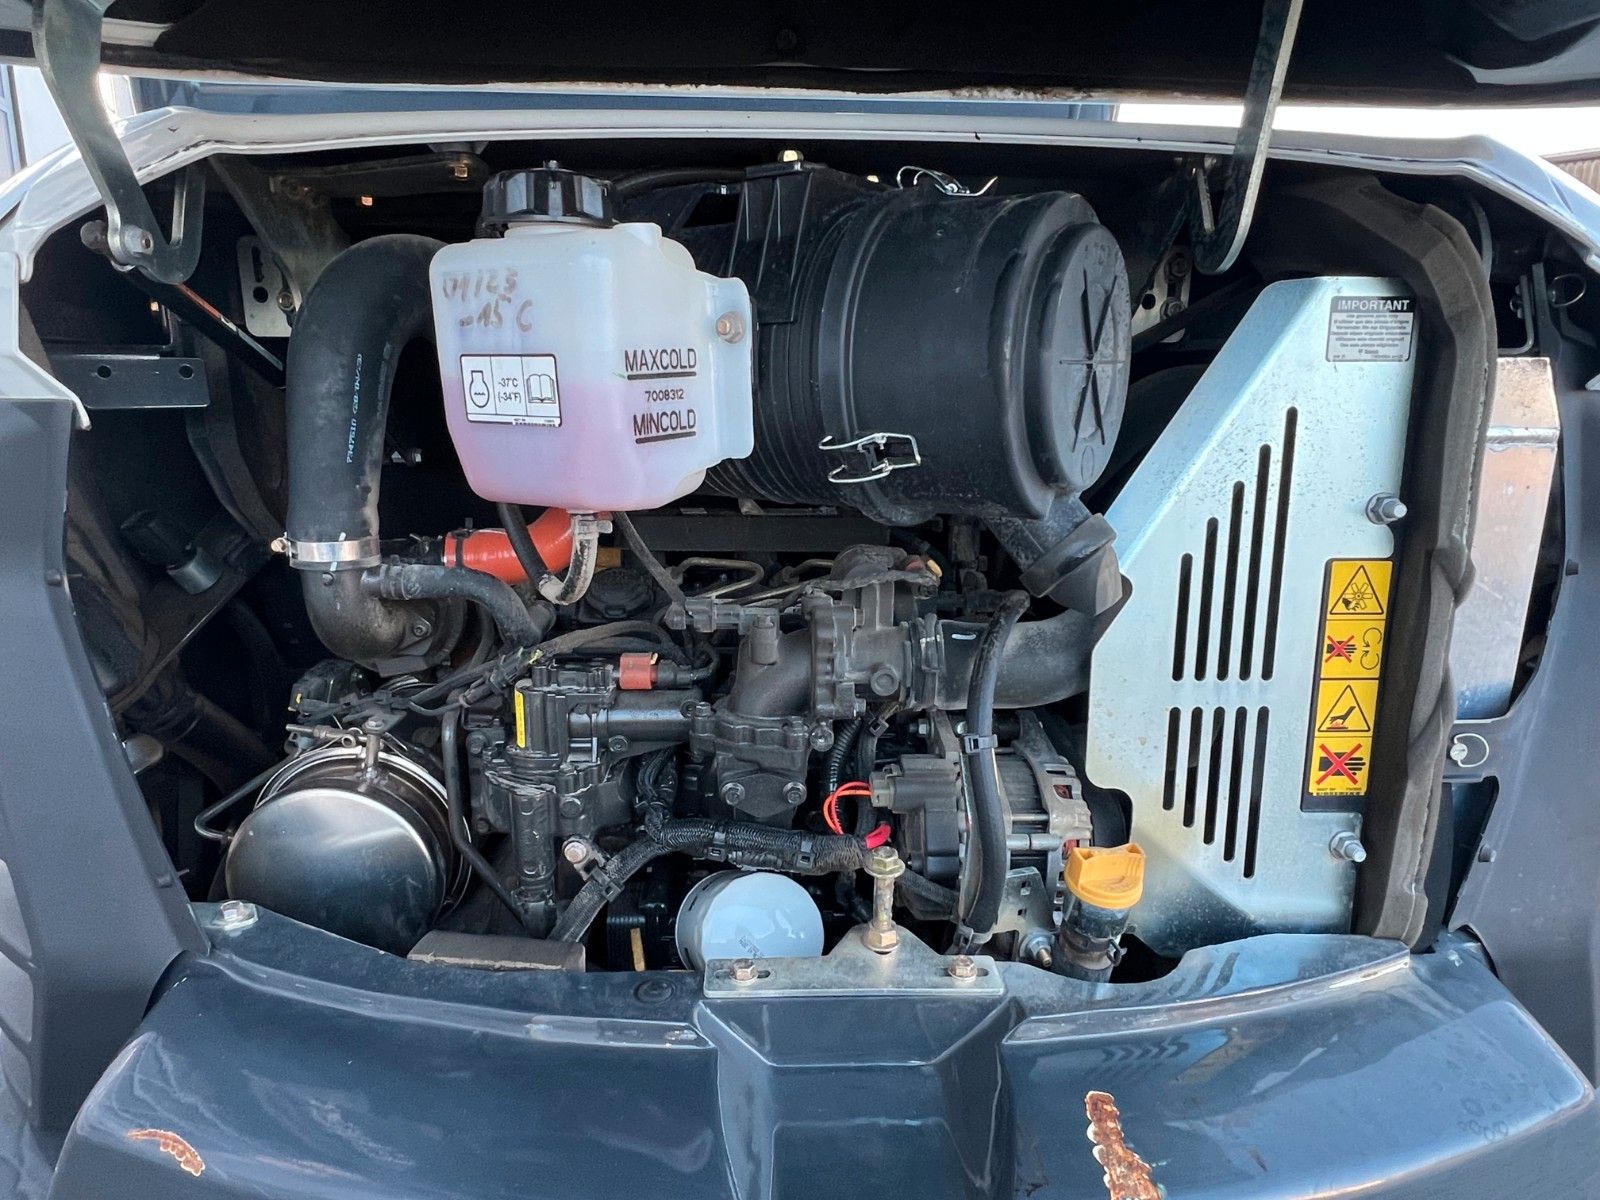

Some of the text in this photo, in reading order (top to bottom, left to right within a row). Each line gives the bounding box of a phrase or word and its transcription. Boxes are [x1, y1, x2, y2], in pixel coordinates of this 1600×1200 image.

[1338, 300, 1410, 311] IMPORTANT
[624, 348, 697, 372] MAXCOLD
[644, 388, 684, 402] 7008312
[633, 408, 697, 436] MINCOLD
